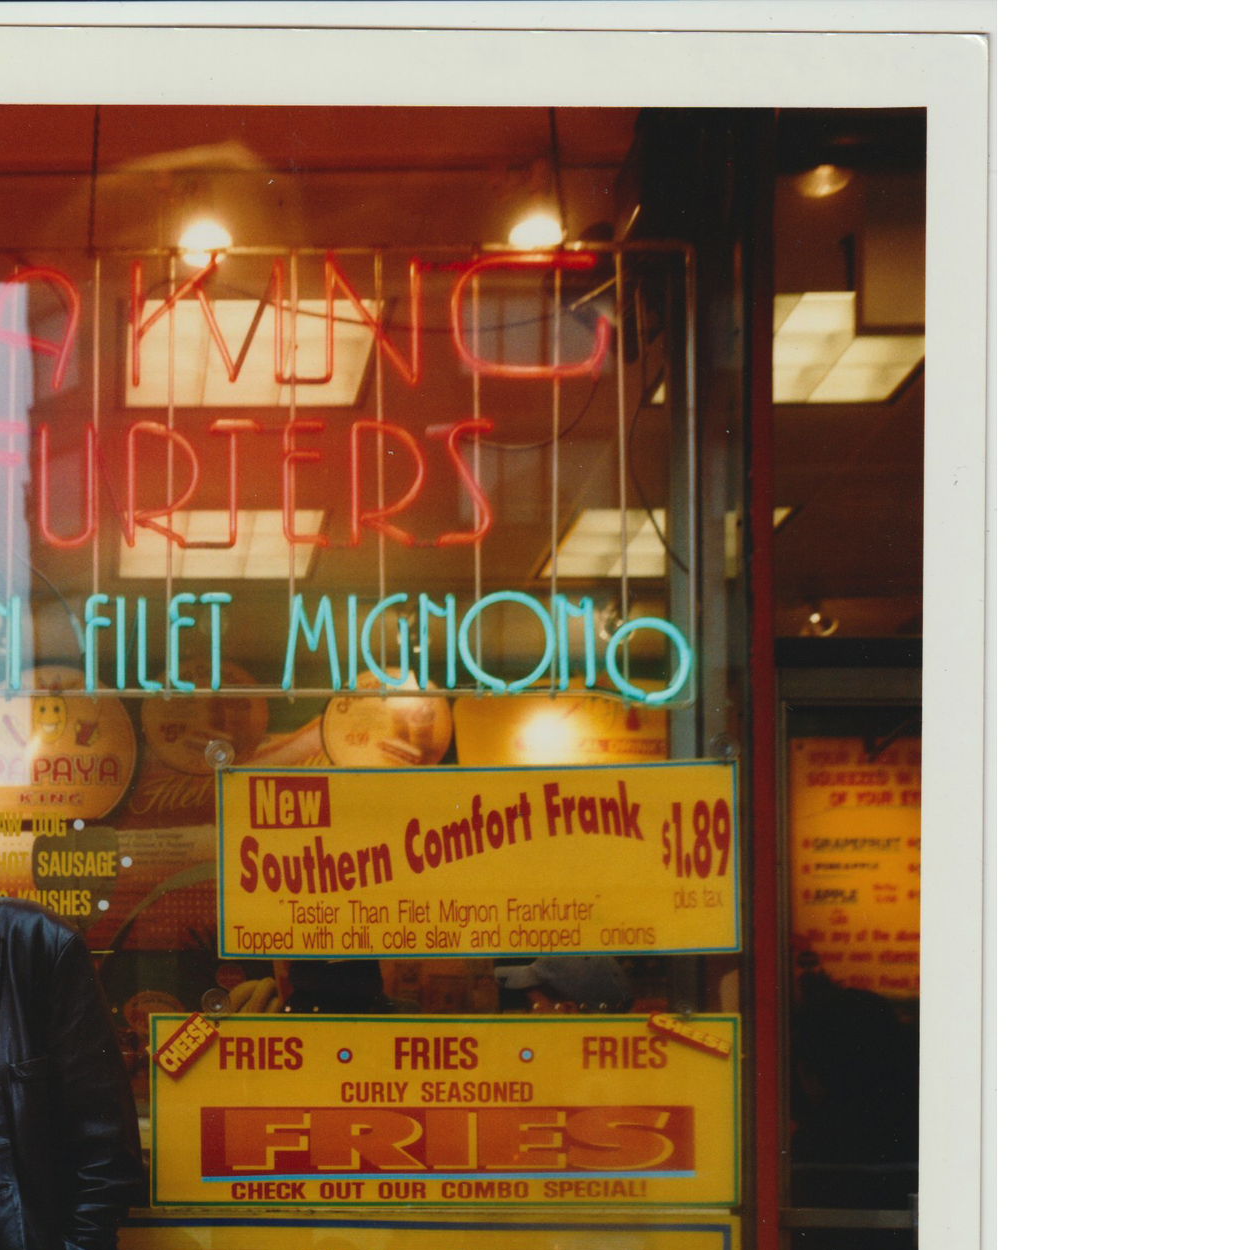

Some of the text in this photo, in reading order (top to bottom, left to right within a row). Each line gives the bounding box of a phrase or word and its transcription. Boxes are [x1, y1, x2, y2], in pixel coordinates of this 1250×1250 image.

[130, 251, 609, 387] KING
[85, 592, 232, 692] FILET
[19, 793, 82, 805] KING
[255, 778, 322, 826] New
[32, 812, 67, 837] DOG
[239, 780, 732, 895] Southern Comfort Frank $1.89
[37, 851, 116, 877] SAUSAGE
[348, 899, 389, 924] Than
[398, 899, 431, 924] Filet
[439, 898, 498, 928] Mignon
[233, 925, 294, 955] Topped
[302, 925, 334, 949] with
[382, 925, 417, 949] cole
[425, 925, 461, 949] slaw
[470, 924, 500, 948] and
[508, 924, 581, 952] chopped
[599, 922, 656, 946] onions
[159, 1015, 216, 1073] CHEESE
[219, 1036, 668, 1070] FRIES FRIES FRIES
[340, 1081, 534, 1103] CURLY SEASONED
[225, 1109, 675, 1170] FRIES
[231, 1180, 647, 1200] CHECK OUT OUR COMBO SPECIAL!
